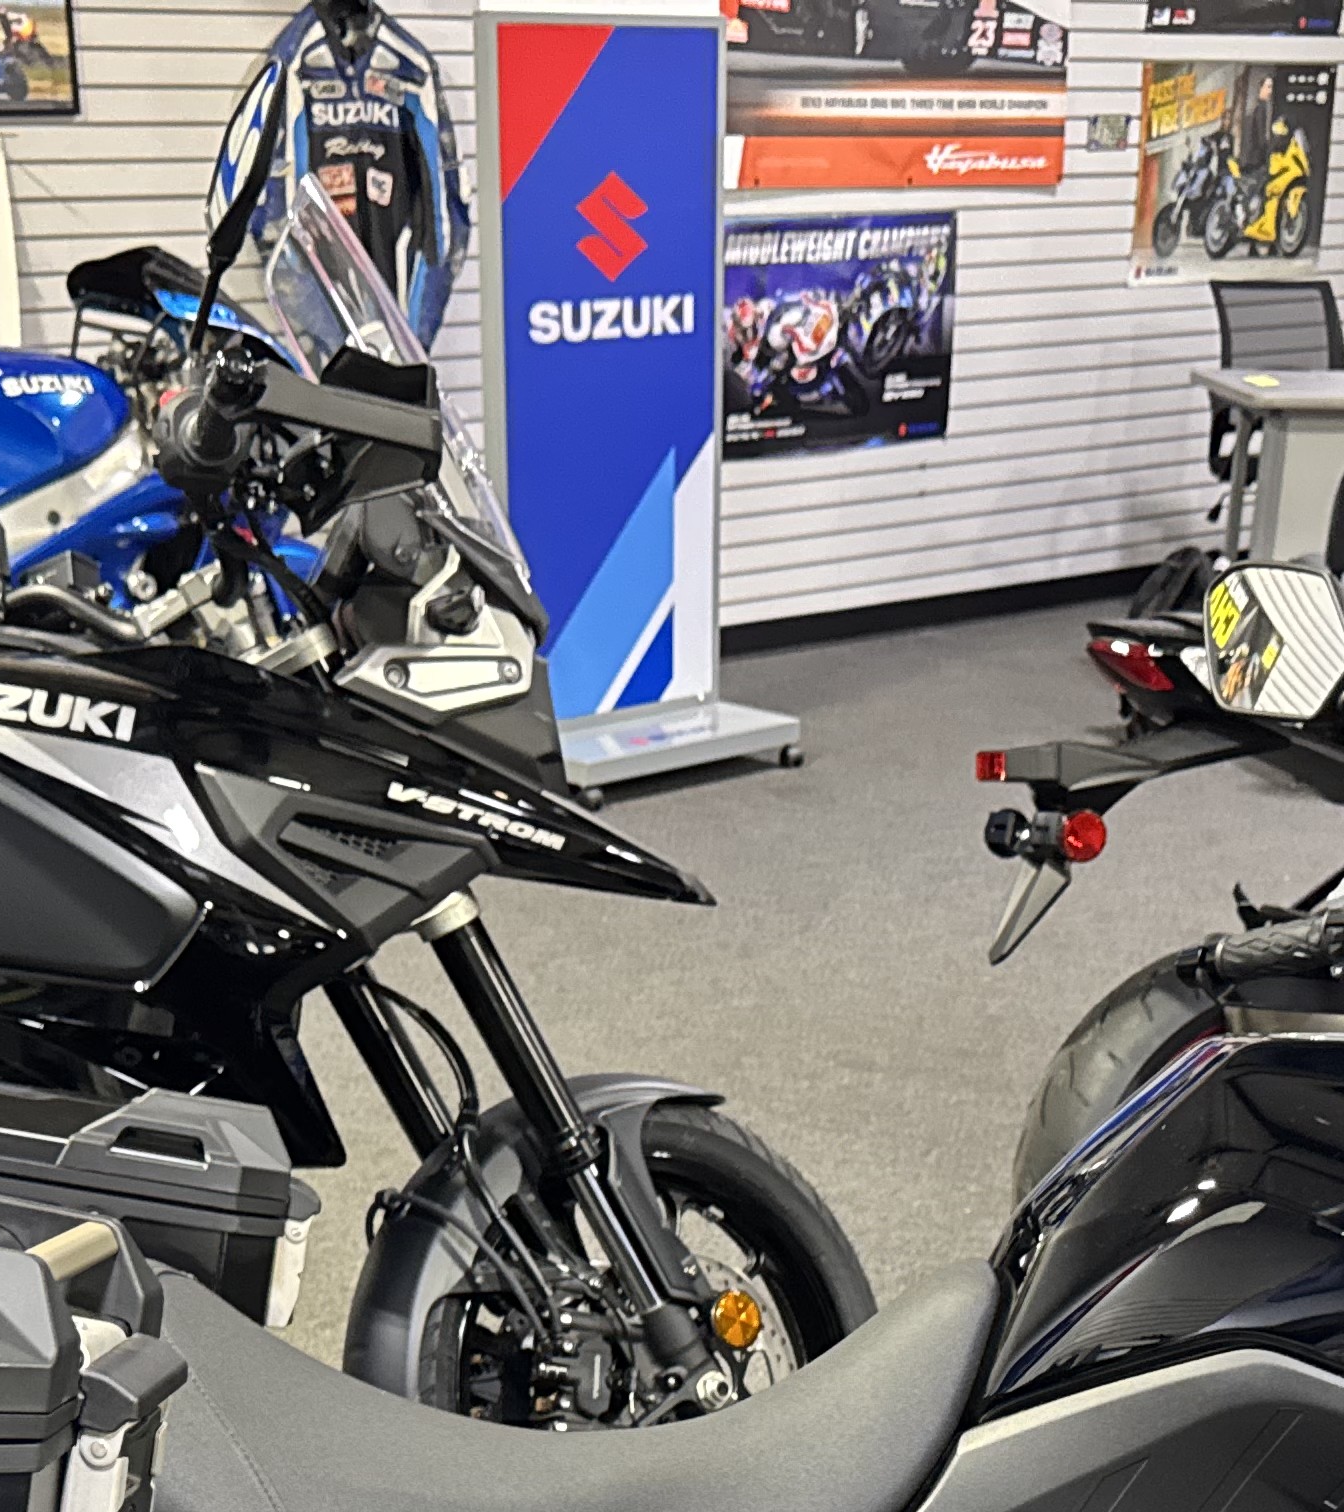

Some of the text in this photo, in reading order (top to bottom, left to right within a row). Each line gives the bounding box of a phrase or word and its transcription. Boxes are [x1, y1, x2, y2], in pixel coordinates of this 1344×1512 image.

[311, 102, 400, 128] SUZUKI
[529, 290, 695, 344] SUZUKI
[0, 374, 94, 397] SUZUKI
